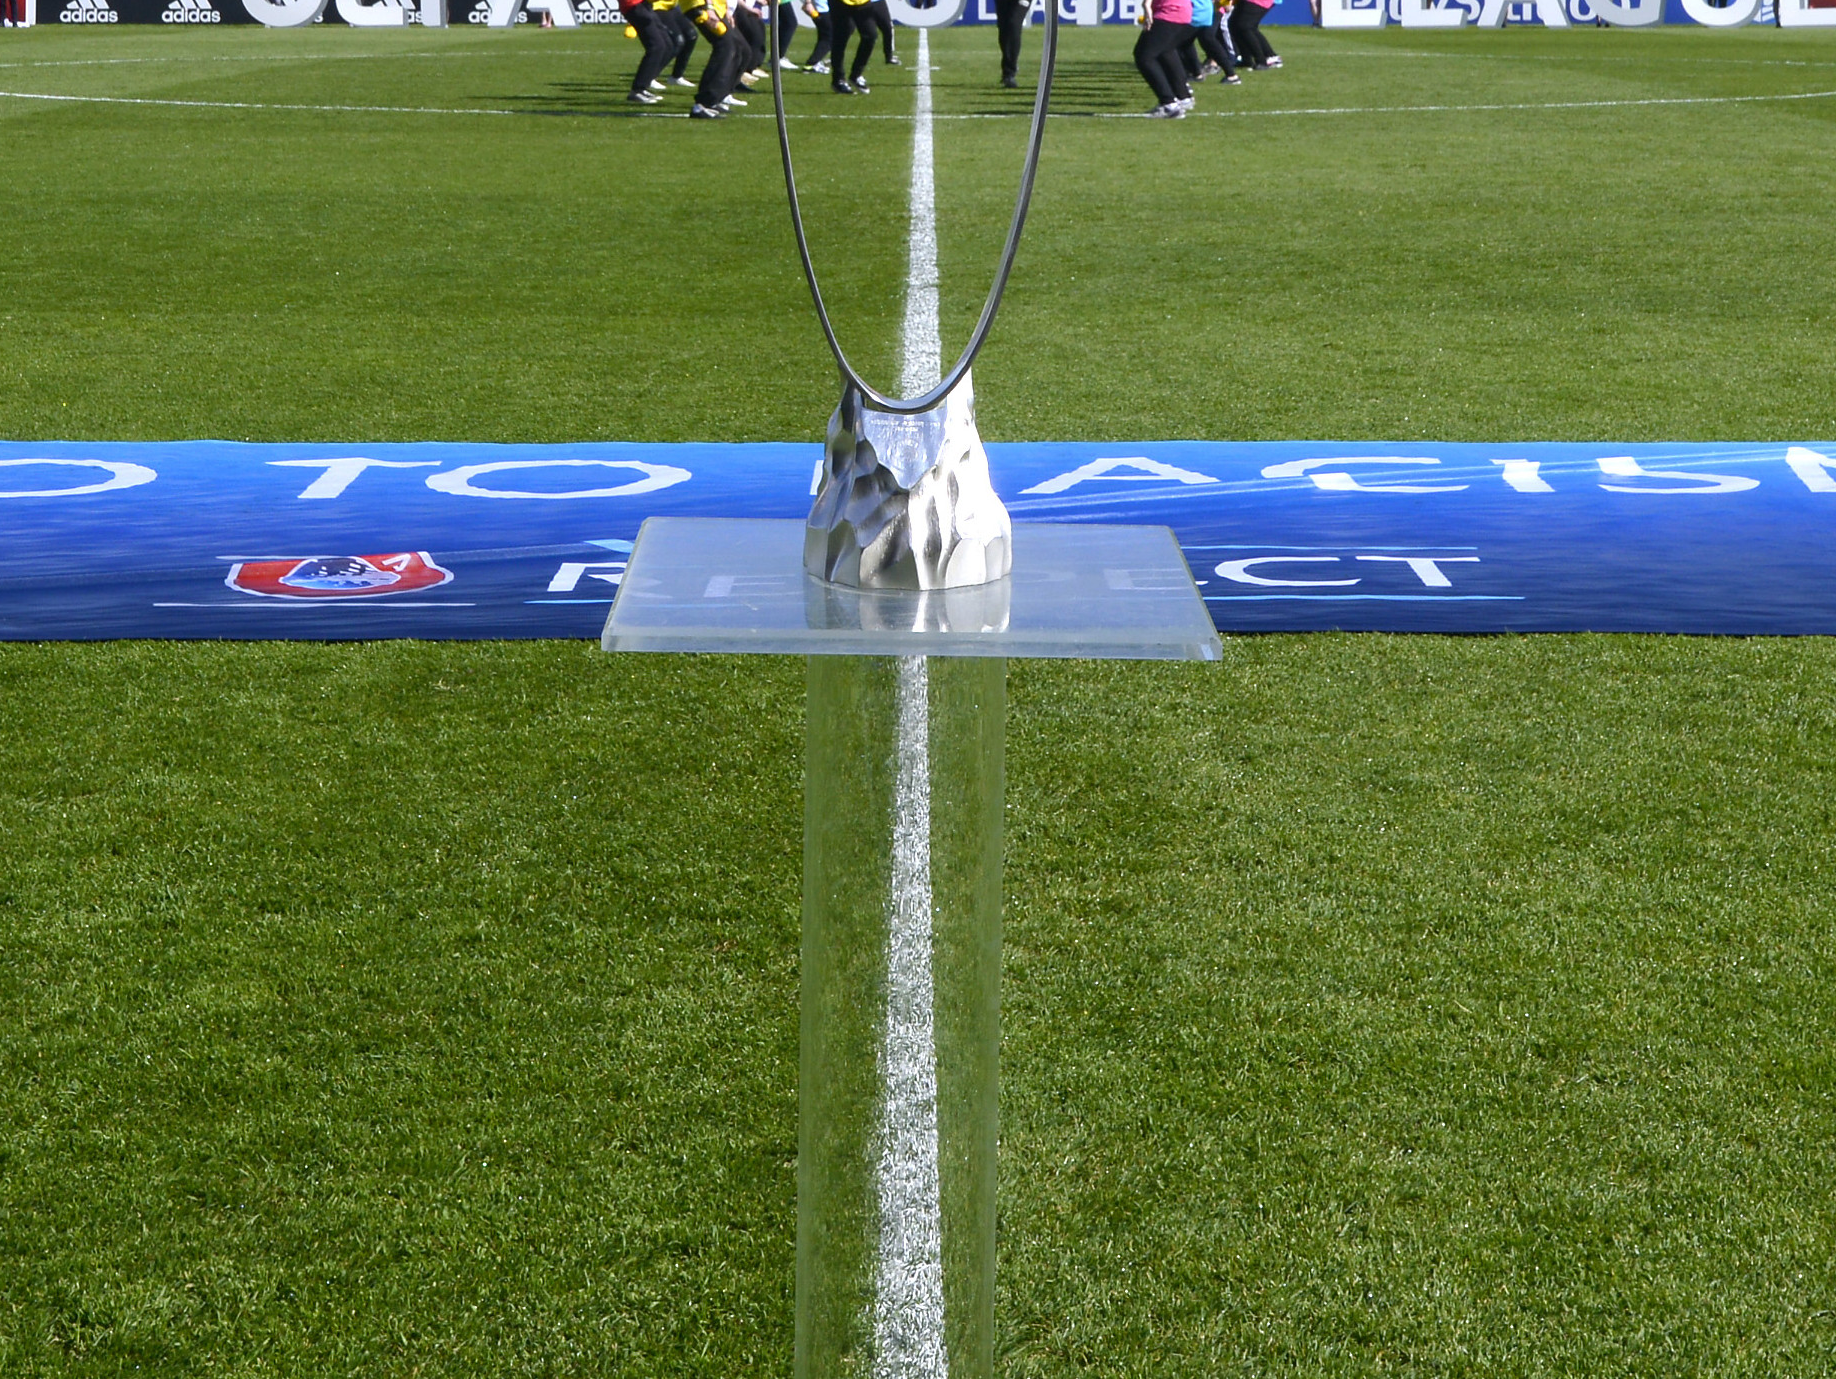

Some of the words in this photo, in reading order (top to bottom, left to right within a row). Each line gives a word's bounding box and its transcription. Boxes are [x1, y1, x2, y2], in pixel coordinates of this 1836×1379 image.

[60, 8, 119, 23] adidas
[162, 8, 221, 23] adidas
[267, 456, 693, 500] TO
[547, 556, 1481, 598] REECT
